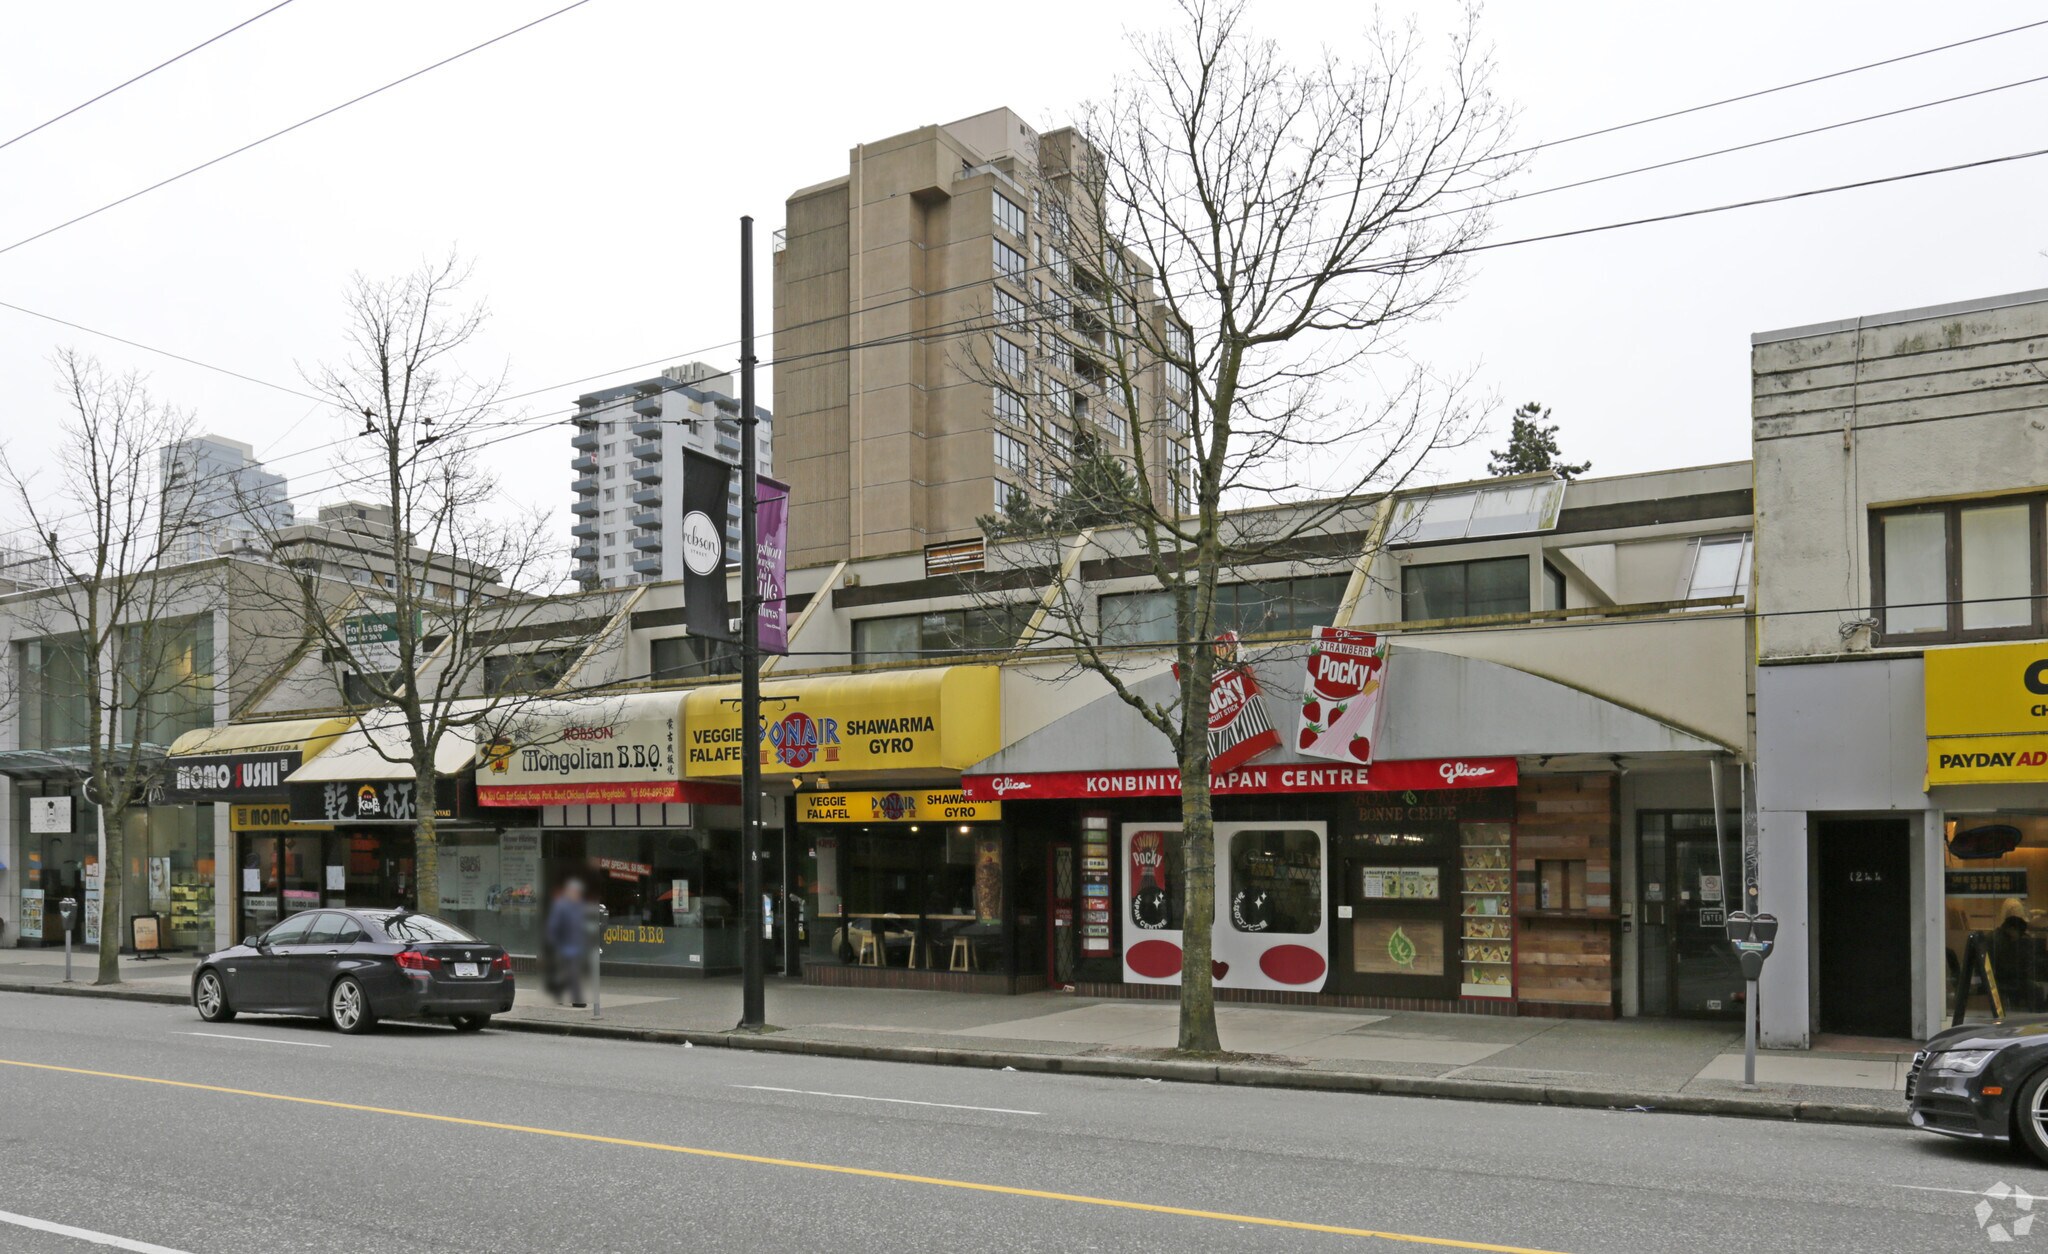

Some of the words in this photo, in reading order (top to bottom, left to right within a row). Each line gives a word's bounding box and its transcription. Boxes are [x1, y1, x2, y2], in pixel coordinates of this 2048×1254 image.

[362, 623, 388, 634] Lease
[1320, 641, 1375, 656] STRAWBERRY
[1224, 702, 1240, 716] STICK
[564, 726, 613, 741] ROBSON
[693, 728, 742, 744] VEGGIE
[846, 716, 934, 736] SHAWARMA
[869, 737, 914, 755] GYRO
[522, 747, 614, 775] Mongolian
[775, 747, 819, 764] SPOT
[1940, 752, 2016, 768] PAYDAY
[177, 764, 231, 789] MOMO
[235, 761, 278, 788] SUSHI
[1087, 774, 1182, 792] KONBINIY
[1281, 768, 1369, 787] CENTRE
[1439, 762, 1495, 784] Glico
[992, 777, 1031, 795] Glico
[809, 796, 846, 807] VEGGIE
[872, 796, 916, 810] DONAIR
[807, 809, 850, 819] FALAFEL
[944, 807, 976, 818] GYRO
[1360, 807, 1403, 821] BONNE
[1408, 806, 1457, 820] CREPE
[1952, 875, 2010, 883] WESTERN
[1970, 882, 2010, 890] UNION
[1134, 894, 1142, 920] JAPAN
[1140, 918, 1167, 930] CENTRE
[1702, 914, 1723, 922] ENTER
[604, 925, 635, 944] golian
